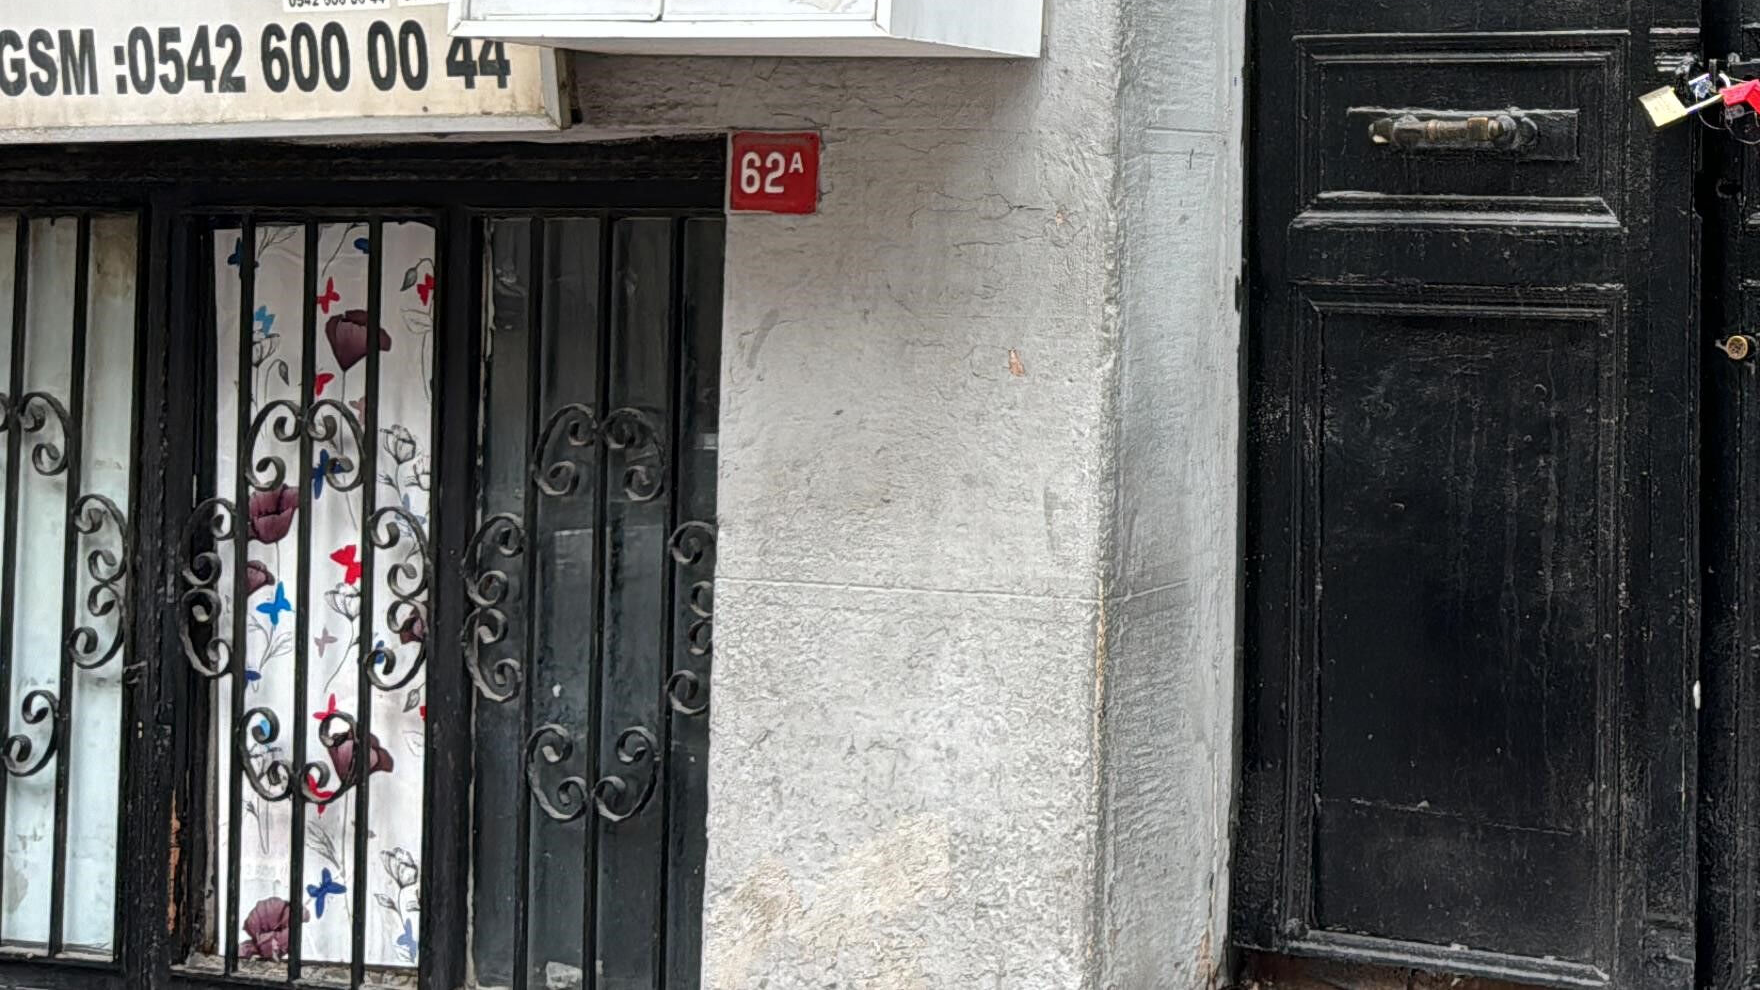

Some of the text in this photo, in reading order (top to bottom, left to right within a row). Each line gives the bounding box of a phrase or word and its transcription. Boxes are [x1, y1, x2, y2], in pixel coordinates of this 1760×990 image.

[0, 28, 99, 97] GSM
[261, 20, 351, 93] 600
[367, 19, 429, 91] 00
[446, 36, 511, 89] 44
